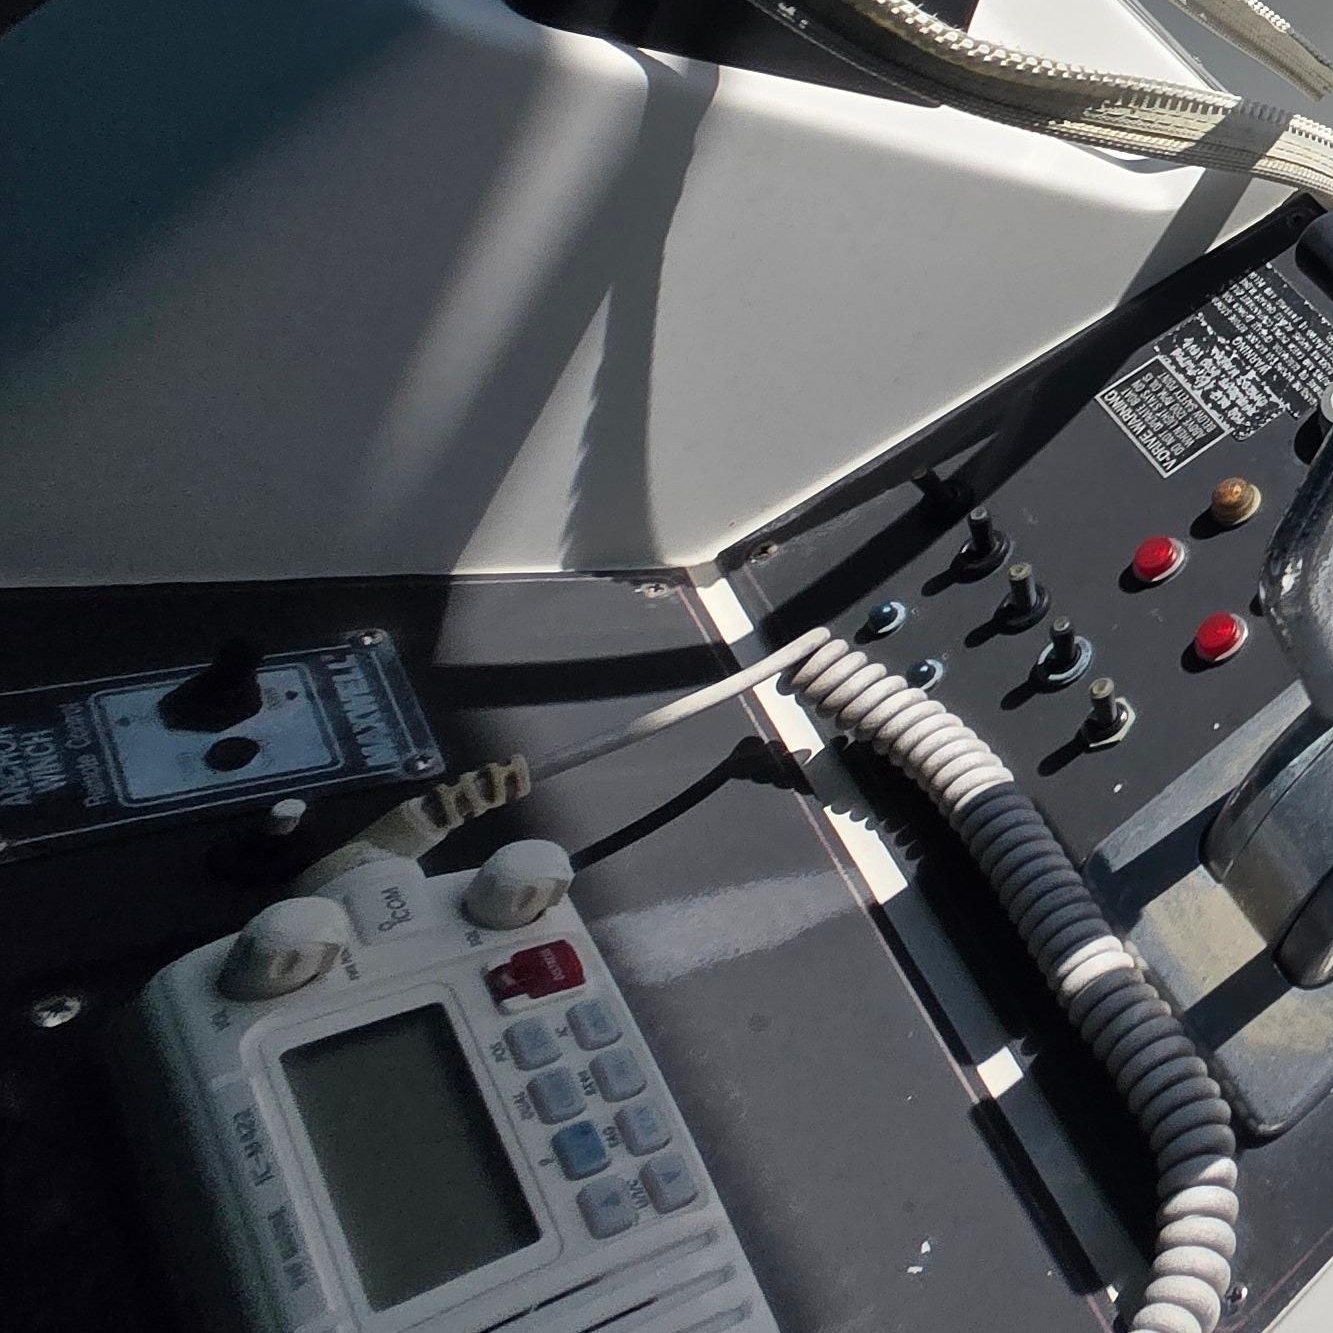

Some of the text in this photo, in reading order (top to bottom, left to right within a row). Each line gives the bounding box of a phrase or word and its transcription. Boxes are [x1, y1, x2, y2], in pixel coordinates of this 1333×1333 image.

[1228, 333, 1273, 375] WARNING
[1140, 370, 1155, 383] IS
[1147, 378, 1164, 392] OIL
[1129, 378, 1197, 448] WHEN LIGHT STAYS ON
[1167, 401, 1189, 420] 1200
[1170, 387, 1200, 413] SAFETY
[1101, 388, 1180, 470] V-DRIVE WARNING
[1119, 385, 1186, 456] DO NOT OPERATE BOAT
[1180, 416, 1207, 440] ABOVE
[1190, 407, 1218, 433] BELOW
[21, 729, 66, 794] WINCH
